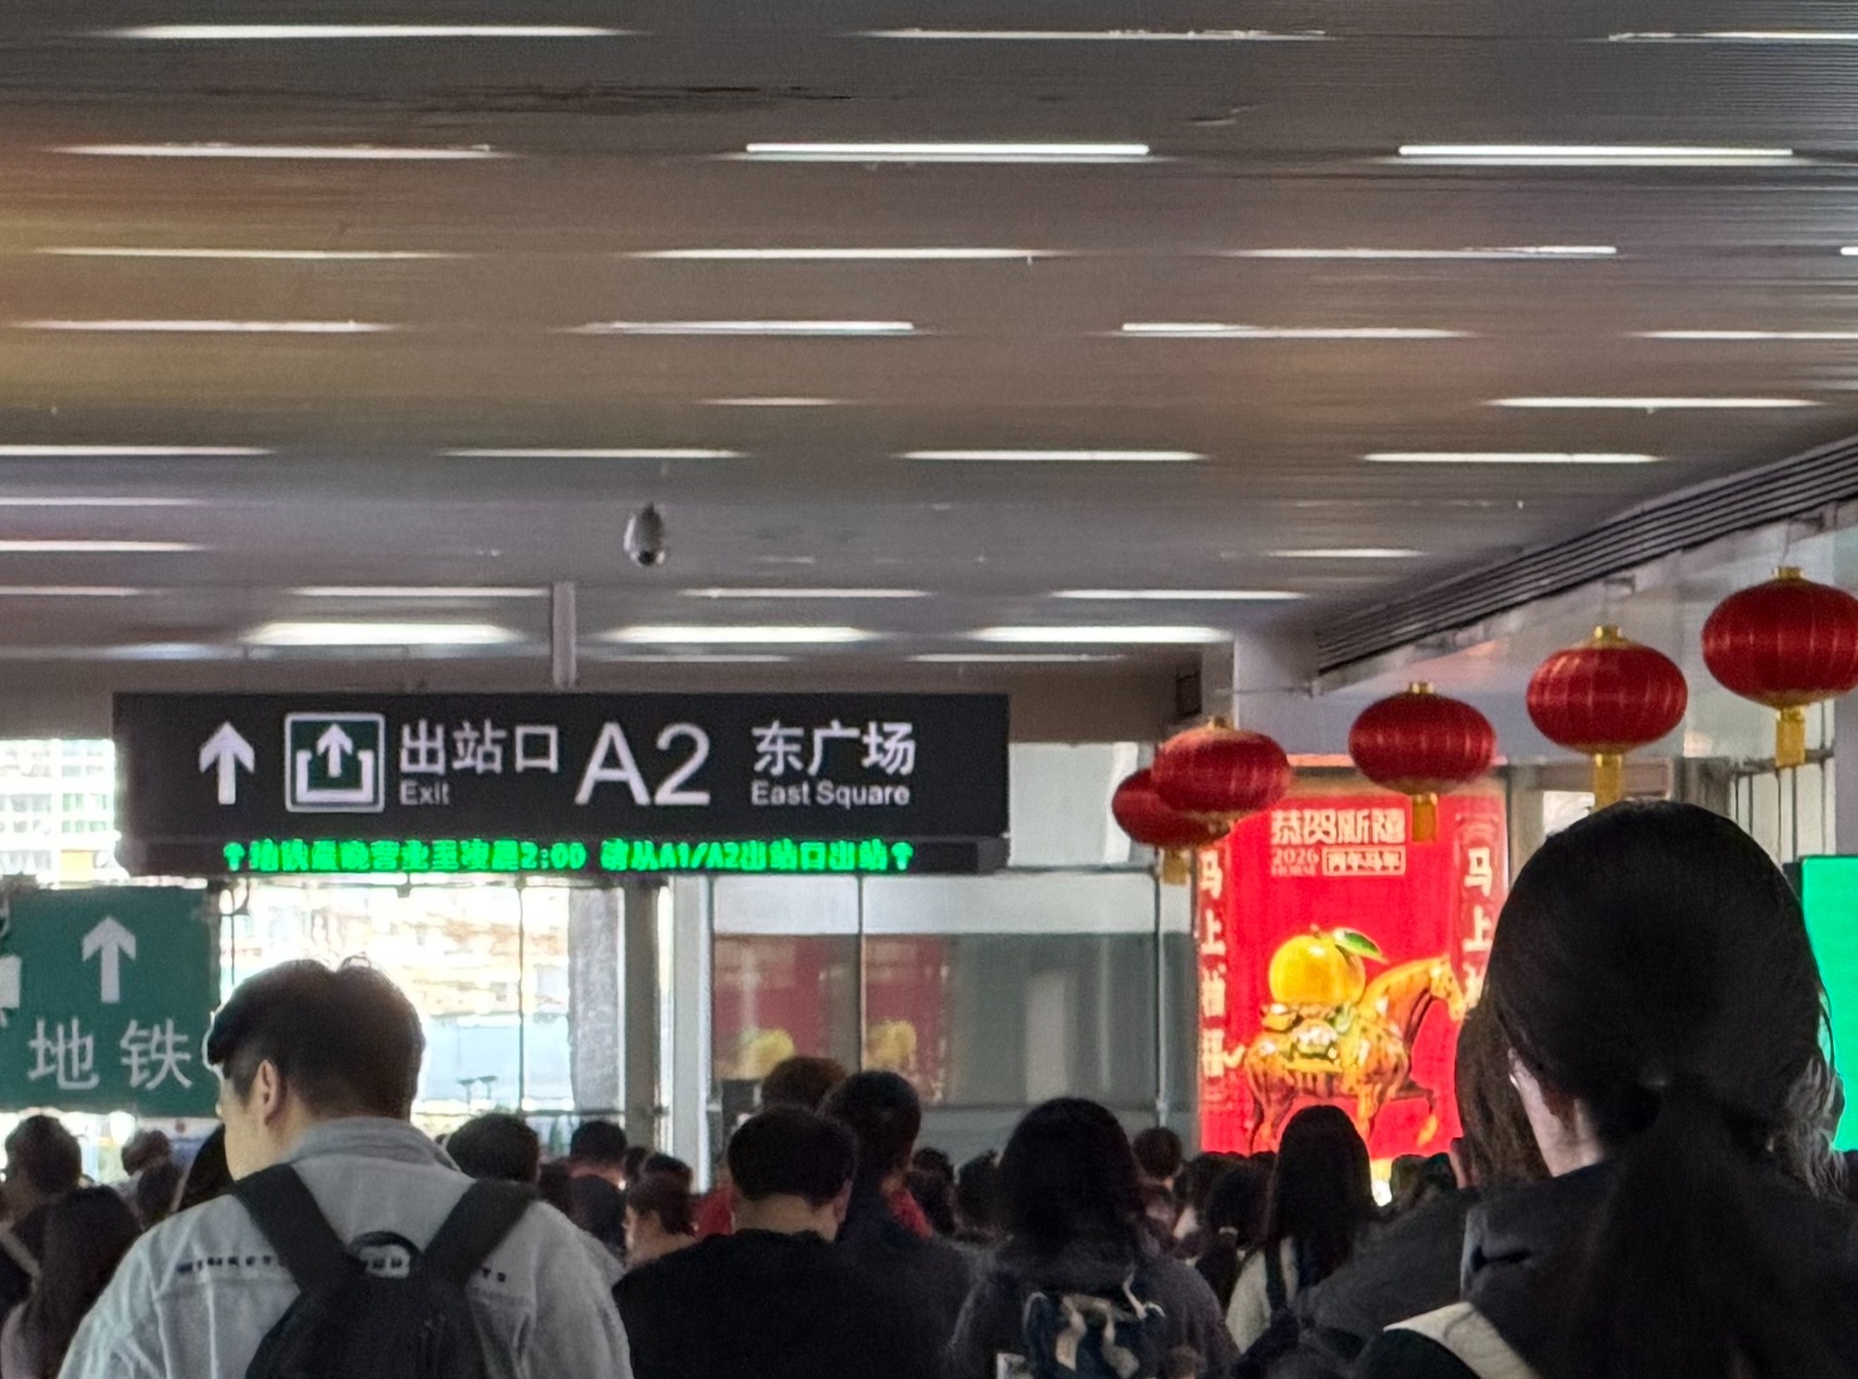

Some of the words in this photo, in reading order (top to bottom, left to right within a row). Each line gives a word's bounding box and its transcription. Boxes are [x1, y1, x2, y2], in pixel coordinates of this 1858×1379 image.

[399, 720, 559, 775] 出站口
[574, 722, 712, 806] A2
[751, 719, 917, 776] 东广场
[399, 780, 450, 806] Exit
[750, 780, 811, 806] East
[816, 780, 911, 810] Square
[1271, 848, 1320, 865] 2026
[28, 1018, 193, 1090] 地铁
